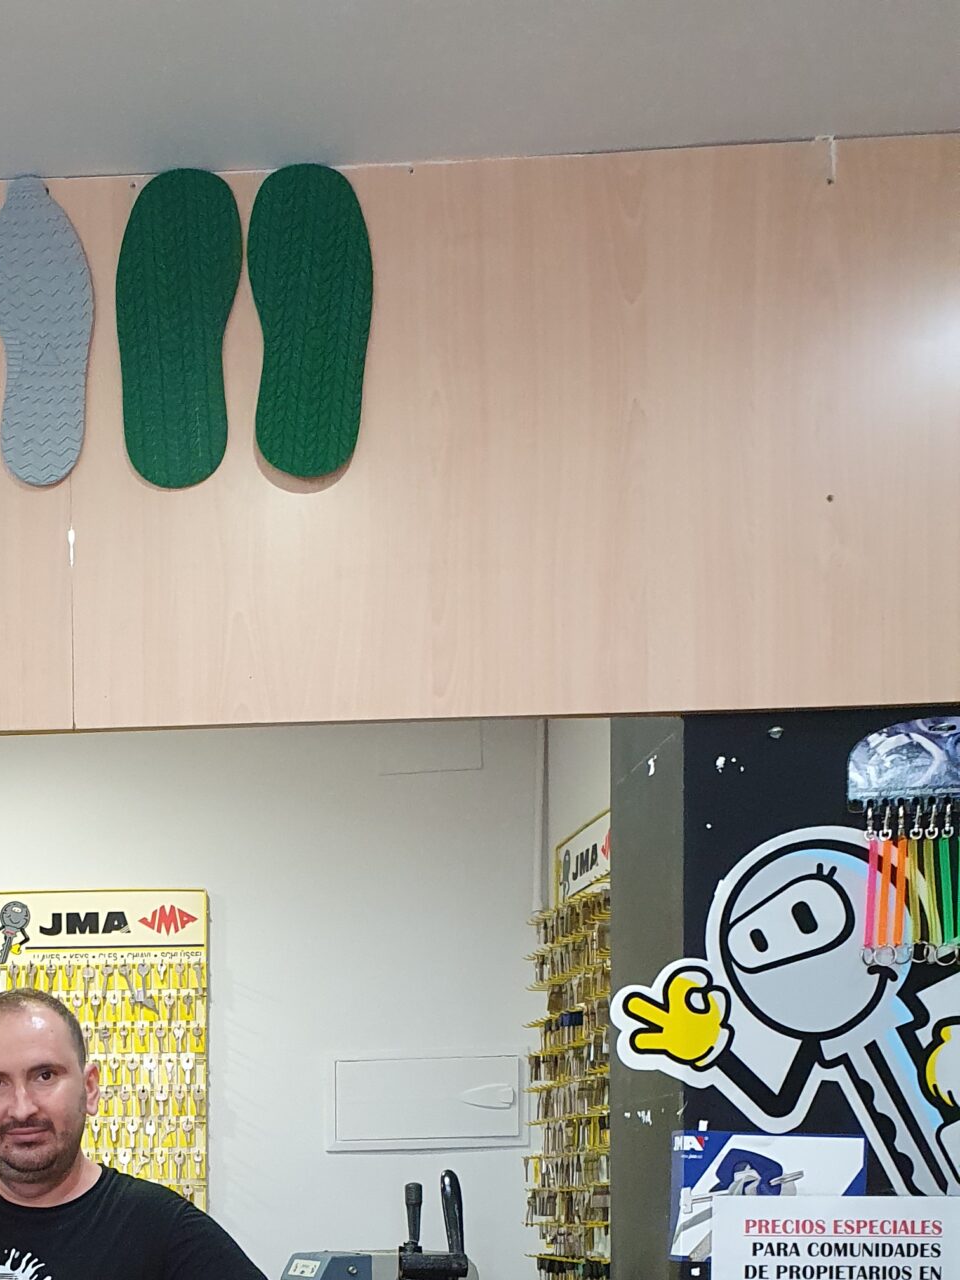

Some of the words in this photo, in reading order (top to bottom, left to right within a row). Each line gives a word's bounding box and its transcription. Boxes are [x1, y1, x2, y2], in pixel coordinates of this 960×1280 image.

[572, 843, 598, 881] JMA
[40, 911, 131, 936] JMA
[744, 1219, 826, 1235] PRECIOS
[833, 1219, 943, 1235] ESPECIALES
[752, 1242, 801, 1257] PARA
[807, 1242, 942, 1258] COMUNIDADES
[744, 1265, 769, 1280] DE
[776, 1265, 913, 1280] PROPIETARIOS
[919, 1265, 942, 1280] EN
